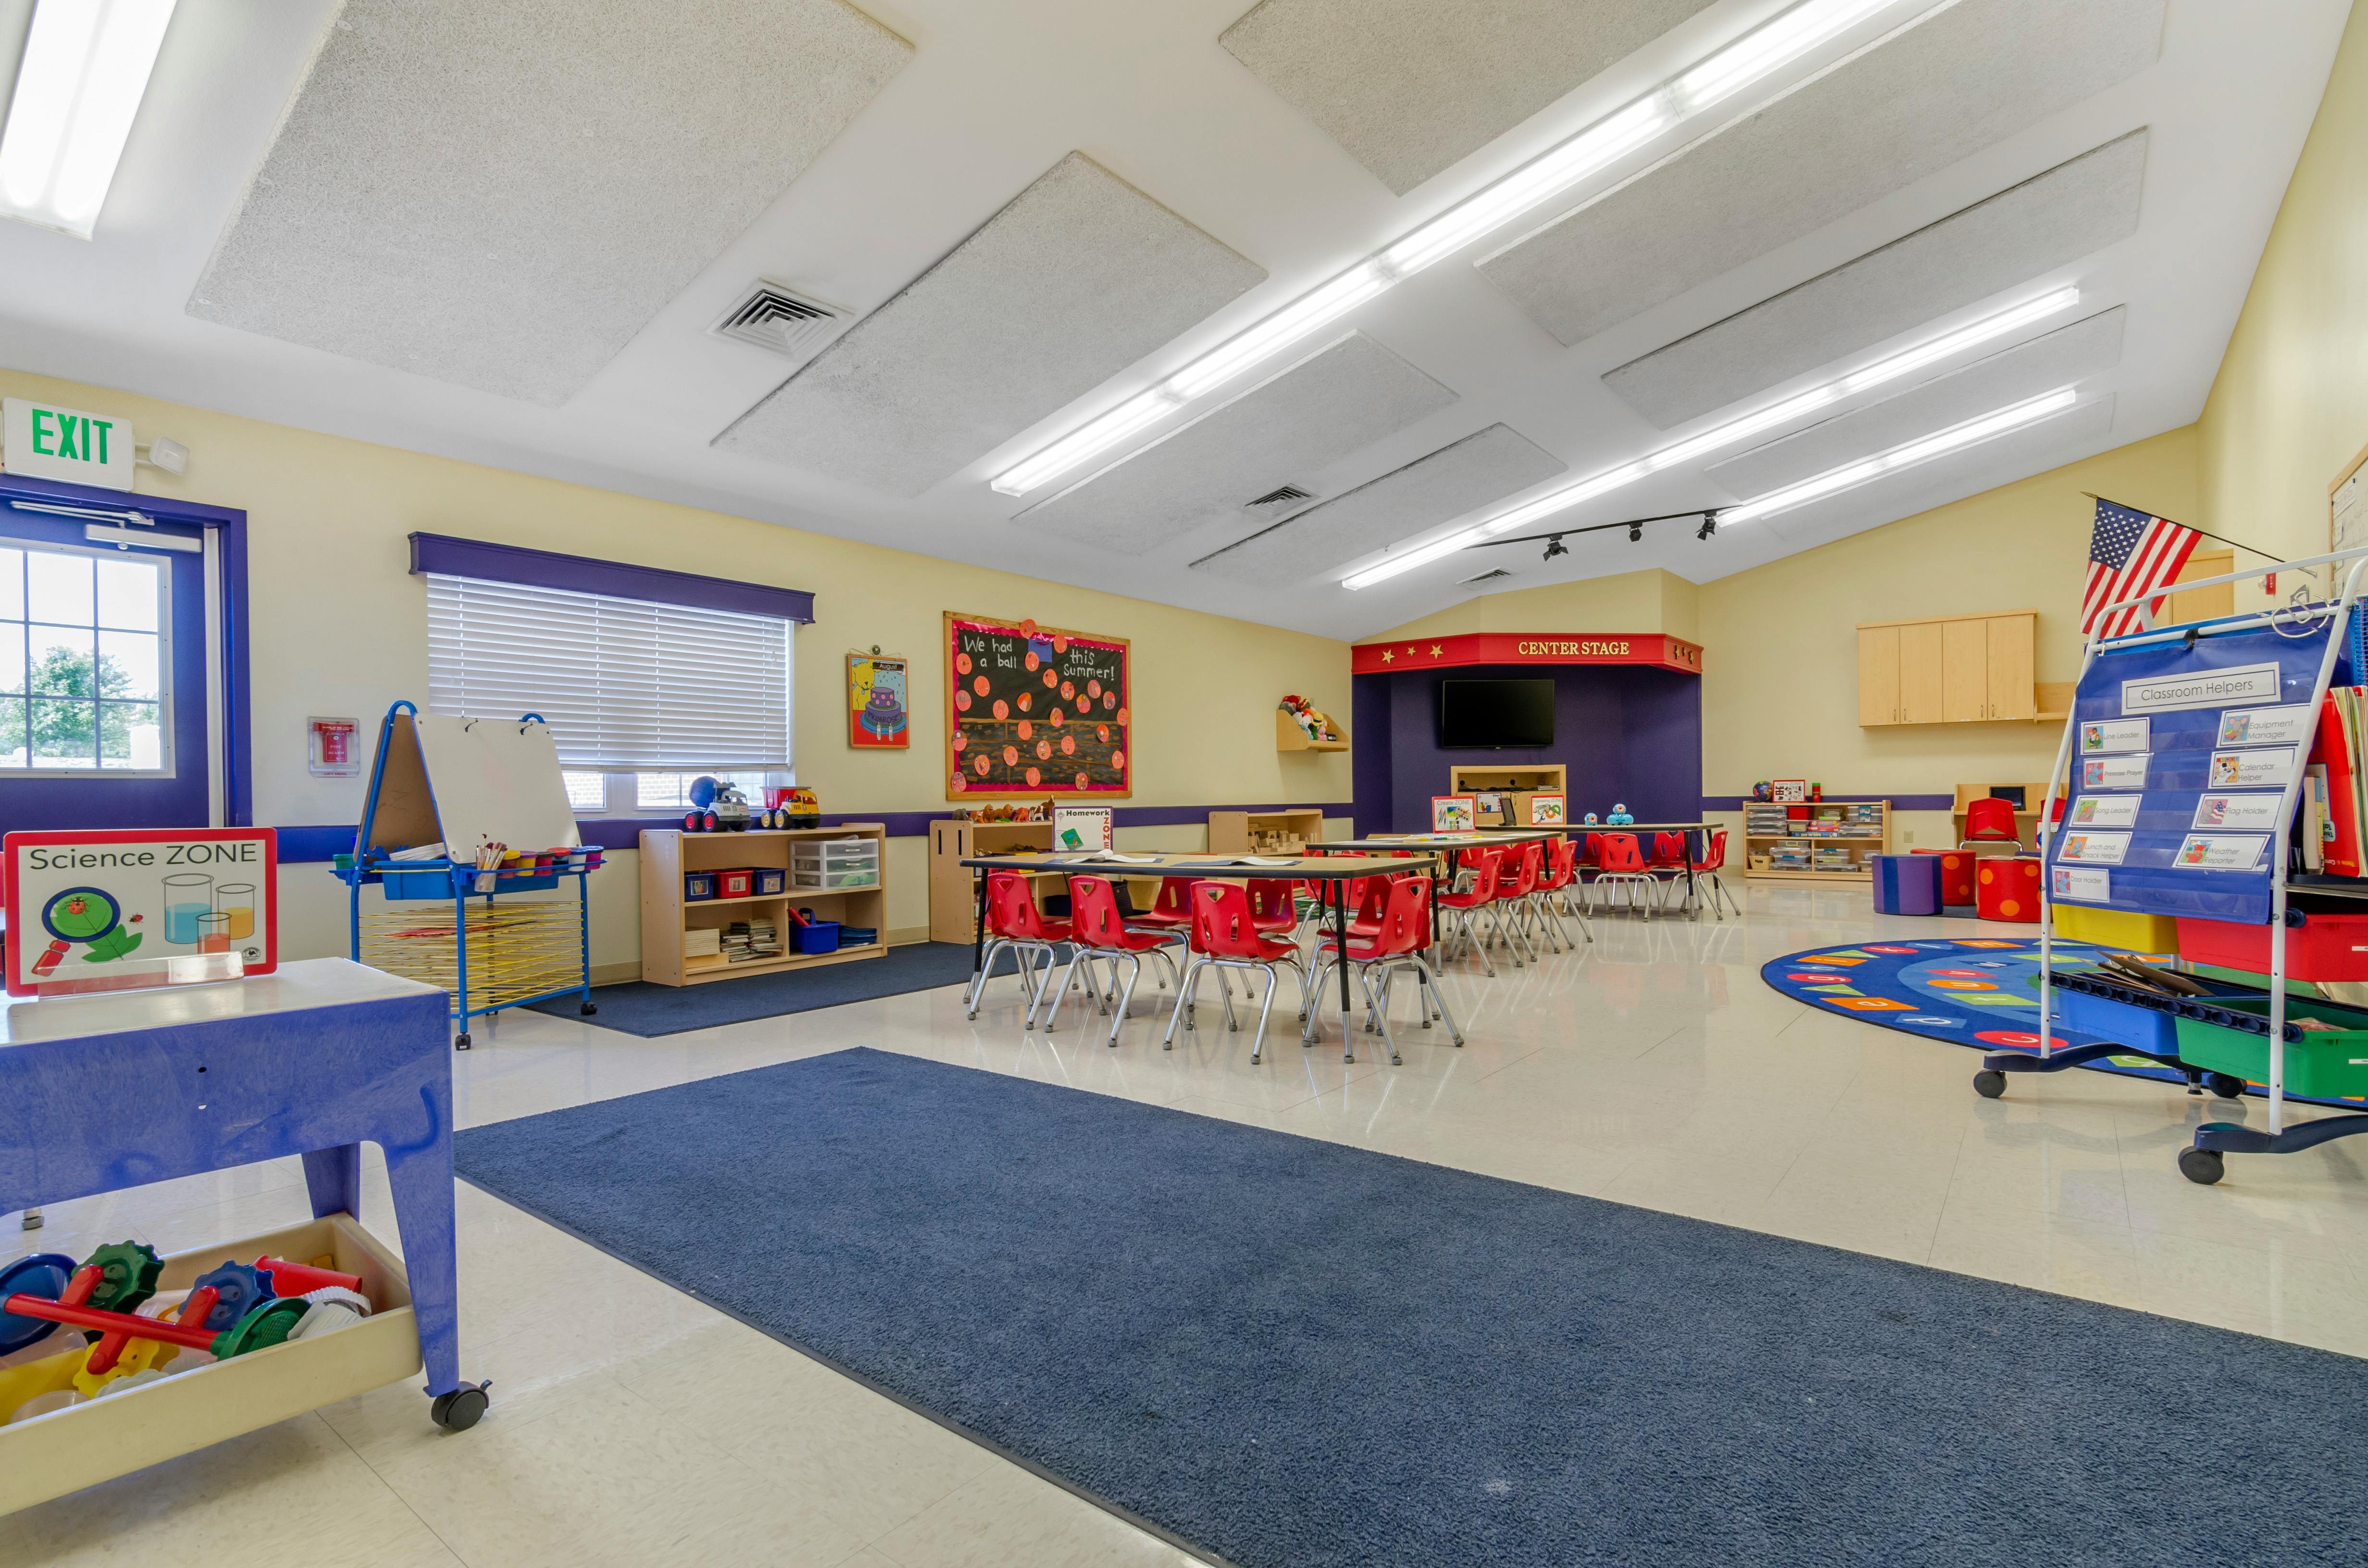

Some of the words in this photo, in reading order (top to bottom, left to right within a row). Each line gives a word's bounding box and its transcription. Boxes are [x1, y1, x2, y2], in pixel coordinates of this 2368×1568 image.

[32, 409, 112, 464] EXIT
[964, 636, 985, 652] We
[992, 638, 1012, 653] had
[1518, 642, 1579, 655] CENTER
[1581, 642, 1629, 655] STAGE
[980, 658, 987, 667] a
[998, 654, 1016, 669] ball
[1070, 649, 1095, 665] this
[2141, 686, 2202, 700] Classroom
[2206, 681, 2253, 695] Helpers
[2249, 720, 2294, 729] Equipment
[2225, 807, 2241, 816] Flag
[30, 848, 155, 870] Science
[166, 844, 258, 865] ZONE
